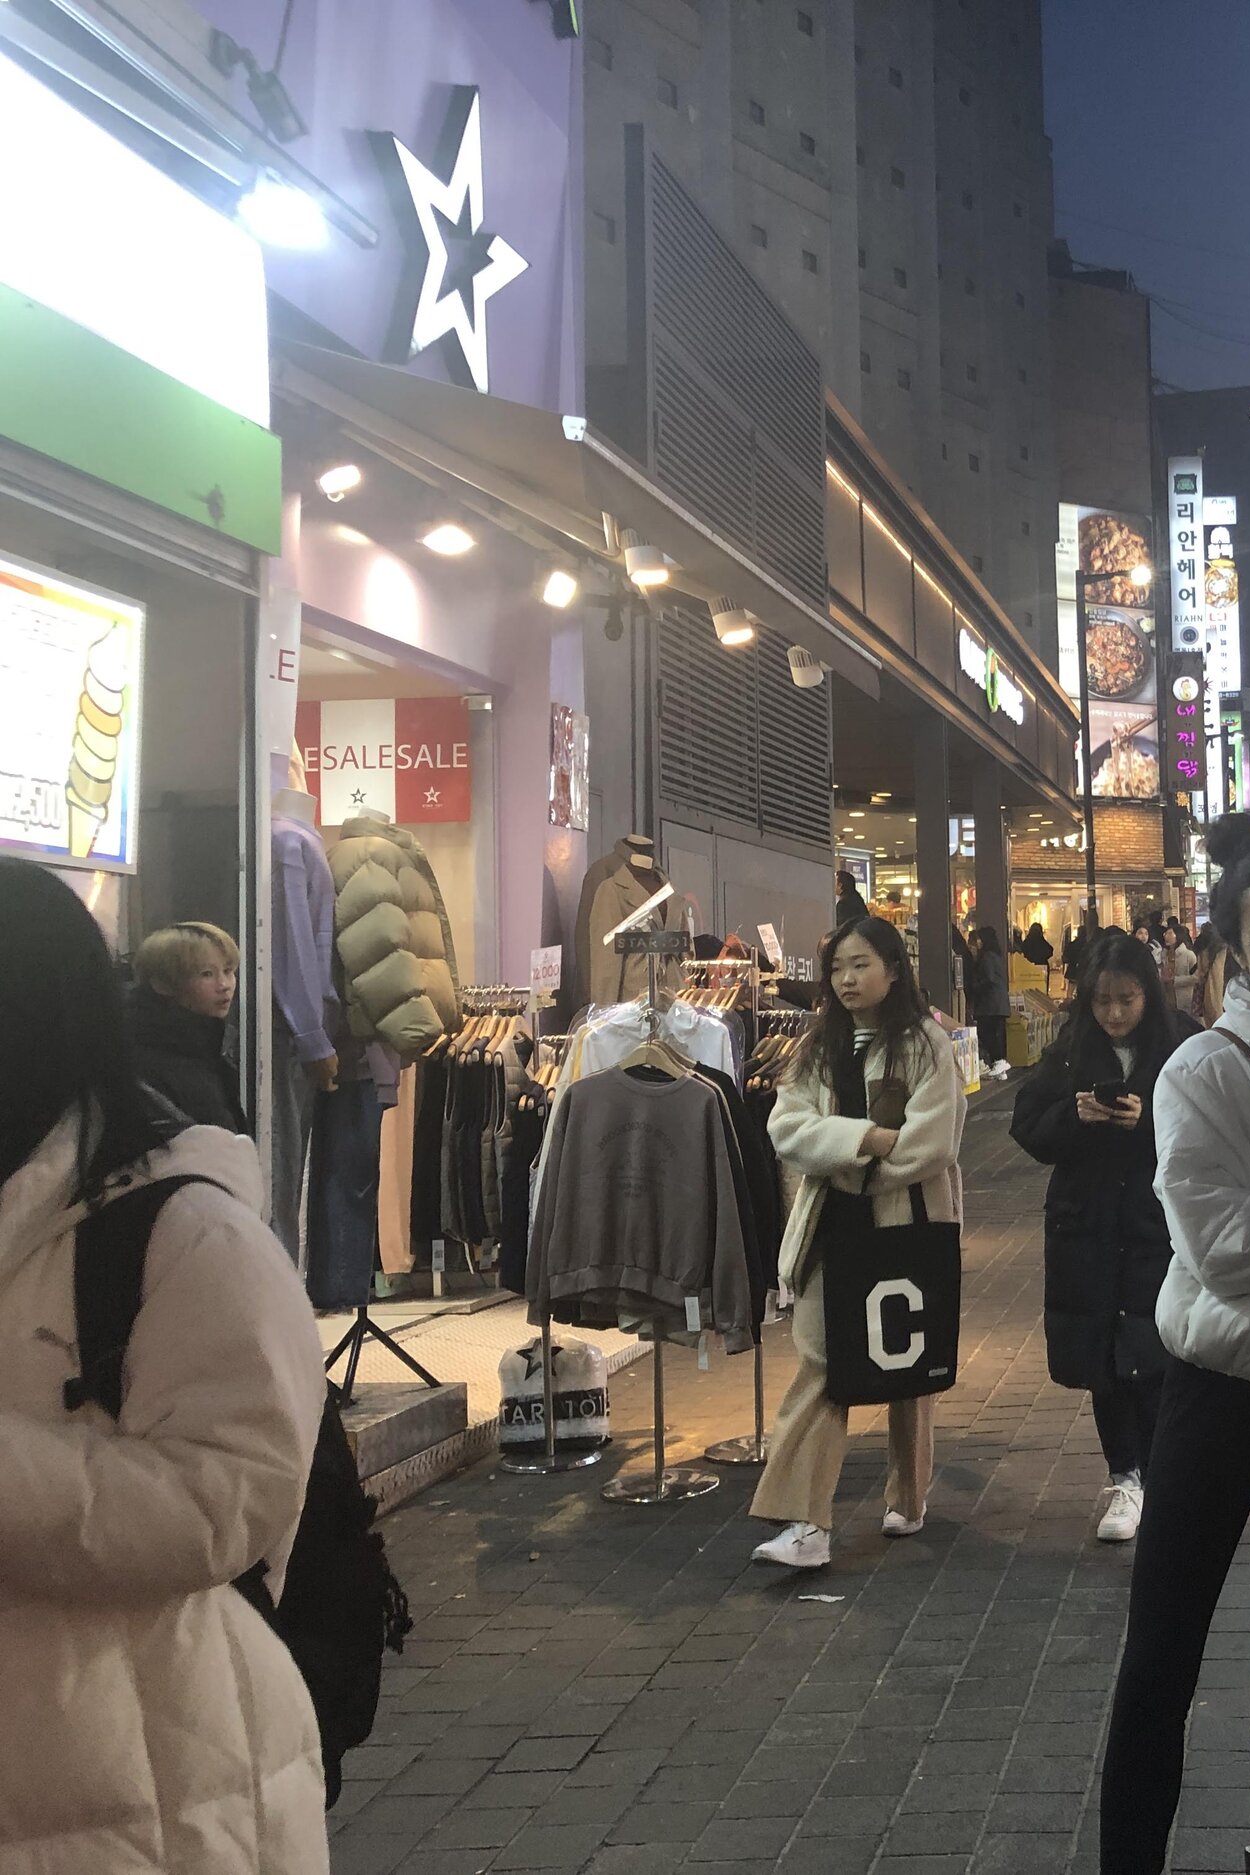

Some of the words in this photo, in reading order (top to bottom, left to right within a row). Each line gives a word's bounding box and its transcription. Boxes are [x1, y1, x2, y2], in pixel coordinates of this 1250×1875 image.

[1176, 501, 1197, 608] 리안헤어
[1174, 615, 1203, 623] RIAHN
[322, 745, 393, 770] SALE
[396, 743, 468, 769] SALE
[617, 937, 657, 949] STAR
[866, 1278, 924, 1371] C
